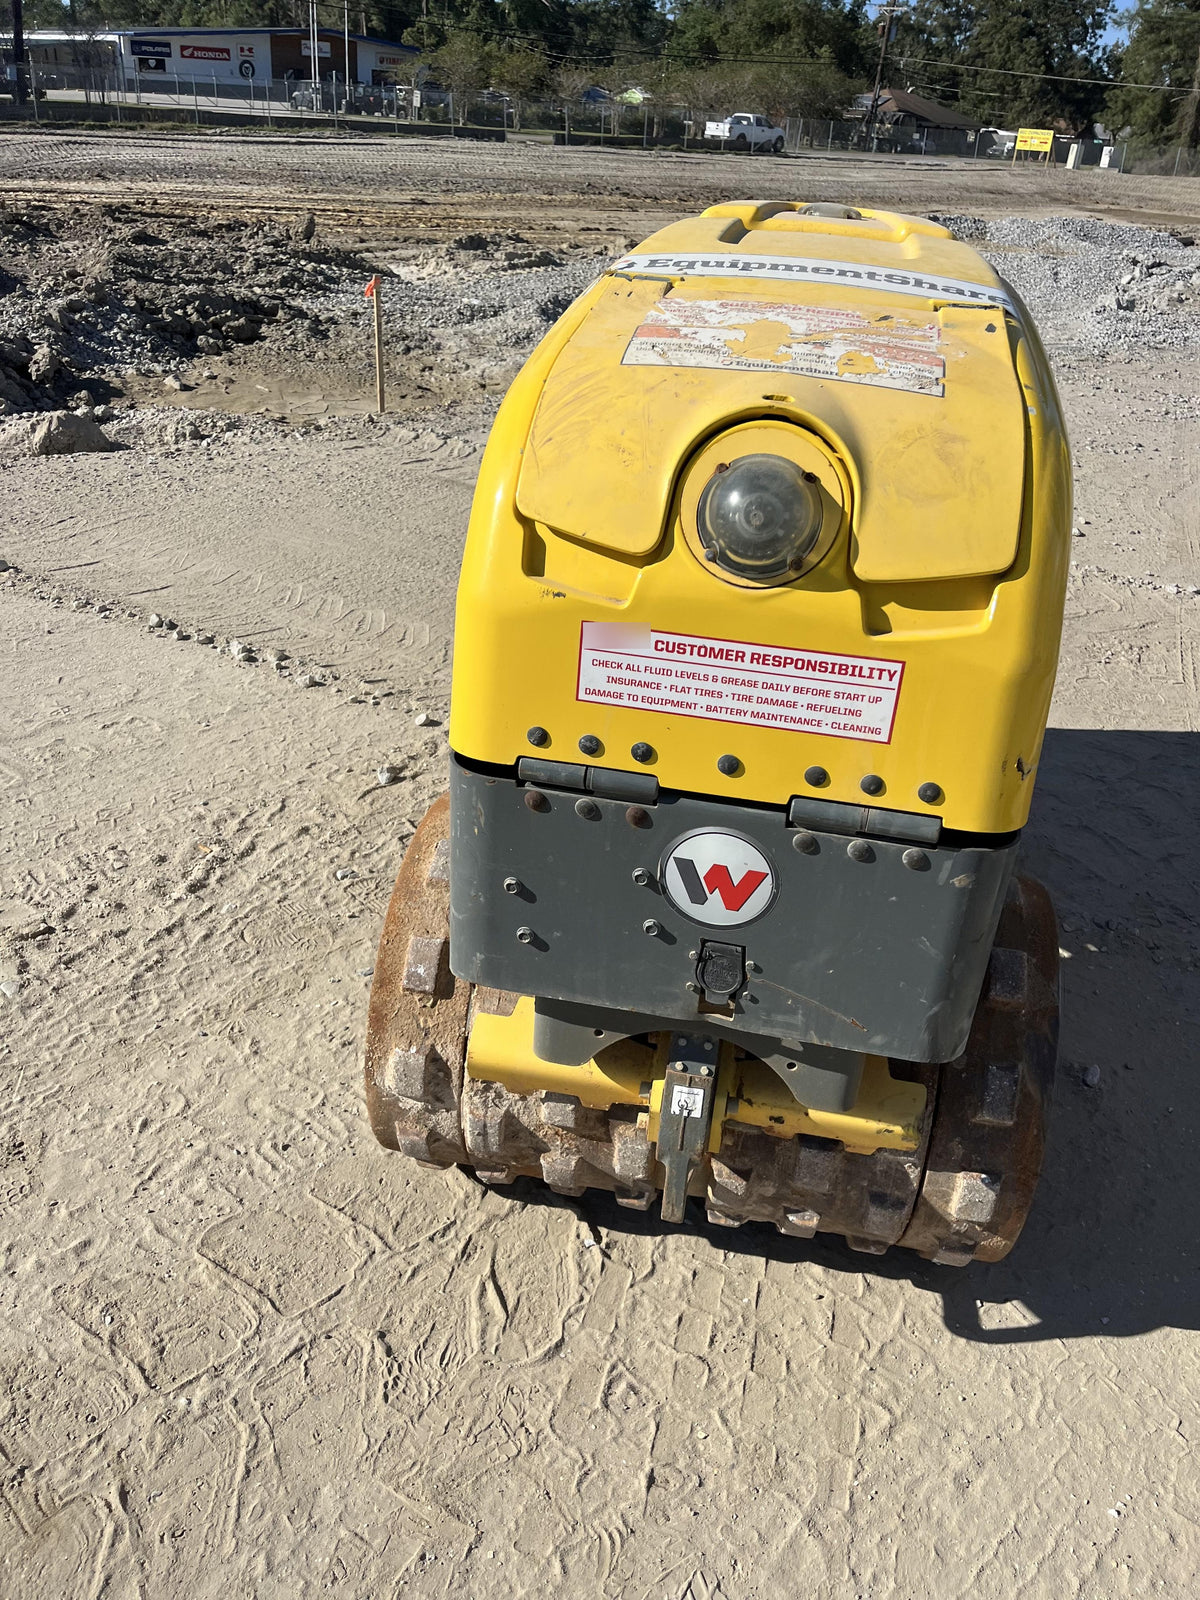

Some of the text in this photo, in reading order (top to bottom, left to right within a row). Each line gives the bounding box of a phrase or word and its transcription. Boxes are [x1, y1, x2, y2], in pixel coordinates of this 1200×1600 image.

[141, 45, 170, 53] POLARIS
[194, 50, 229, 59] HONDA
[644, 258, 1011, 306] EquipmentShare
[592, 658, 882, 704] CHECK ALL FLUID LEVELS & GREASE DAILY BEFORE START UP
[654, 639, 898, 682] CUSTOMER RESPONSIBILITY
[584, 687, 882, 736] DAMAGE TO EQUIPMENT BATTERY MAINTENANCE CLEANING
[606, 675, 862, 718] INSURANCE FLAT TIRES TIRE DAMAGE REFUELING
